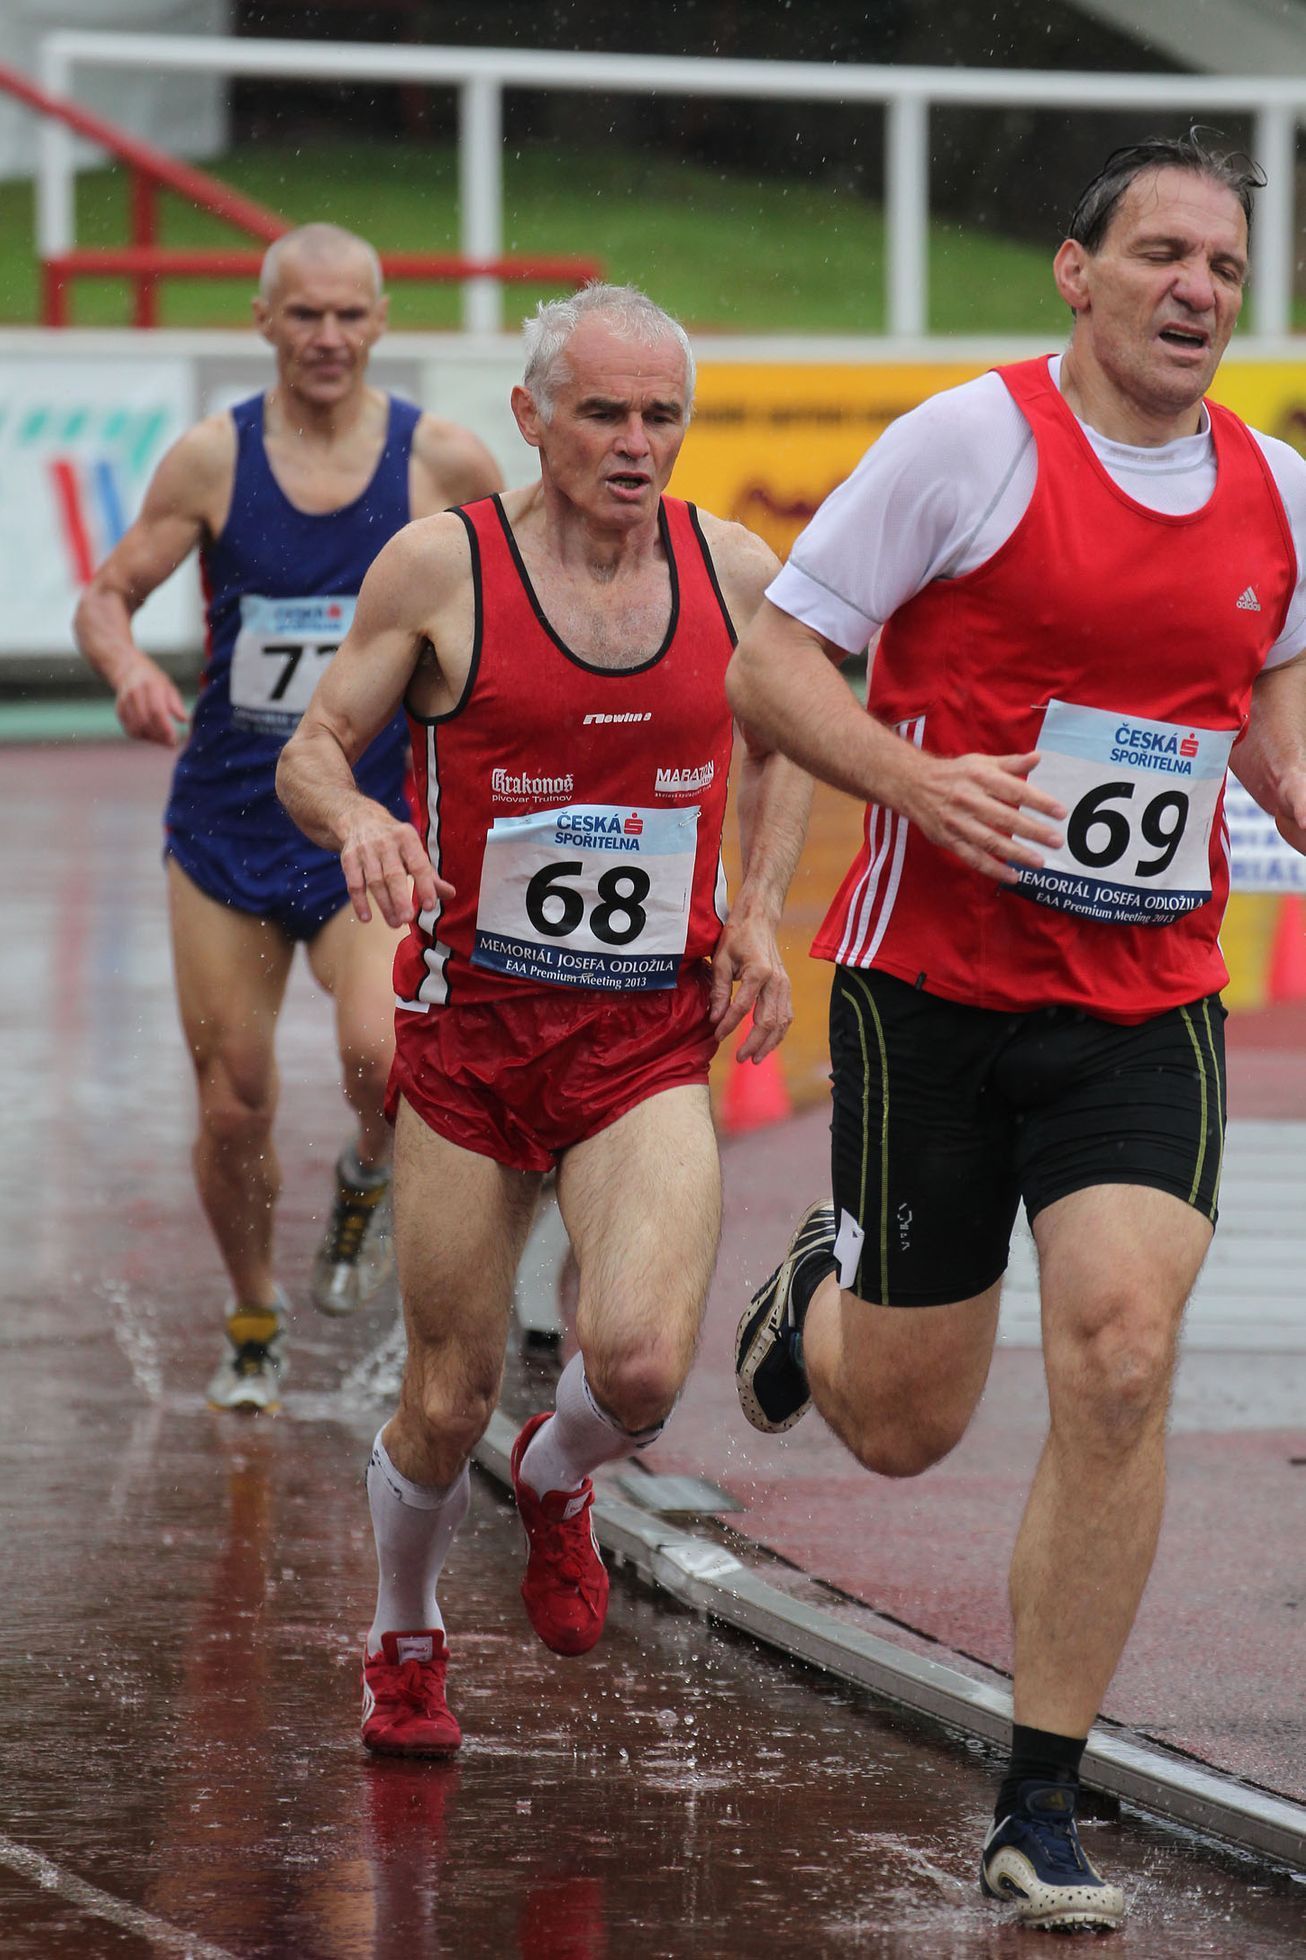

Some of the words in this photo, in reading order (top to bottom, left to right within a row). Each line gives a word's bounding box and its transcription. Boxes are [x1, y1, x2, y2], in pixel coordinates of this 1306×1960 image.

[1236, 600, 1261, 611] adidas
[263, 645, 340, 701] 7
[1115, 722, 1178, 754] ČESKÁ
[1110, 748, 1192, 775] SPOŘITELNA
[491, 768, 574, 795] Krakonoš
[557, 811, 622, 834] ČESKÁ
[1067, 781, 1190, 877] 69
[555, 832, 640, 851] SPOŘITELNA
[525, 861, 651, 946] 68
[1036, 892, 1059, 907] EAA
[1063, 899, 1118, 919] Premium
[1114, 909, 1151, 924] Meeting
[1152, 914, 1175, 923] 2013
[1093, 887, 1141, 907] JOSEFA
[1144, 895, 1204, 911] ODLOŽILA
[480, 938, 553, 965] MEMORIÁL
[557, 953, 605, 972] JOSEFA
[610, 959, 674, 974] ODLOŽILA
[506, 960, 527, 974] EAA
[530, 965, 578, 983] Premium
[579, 975, 622, 990] Meeting
[625, 977, 647, 988] 2013
